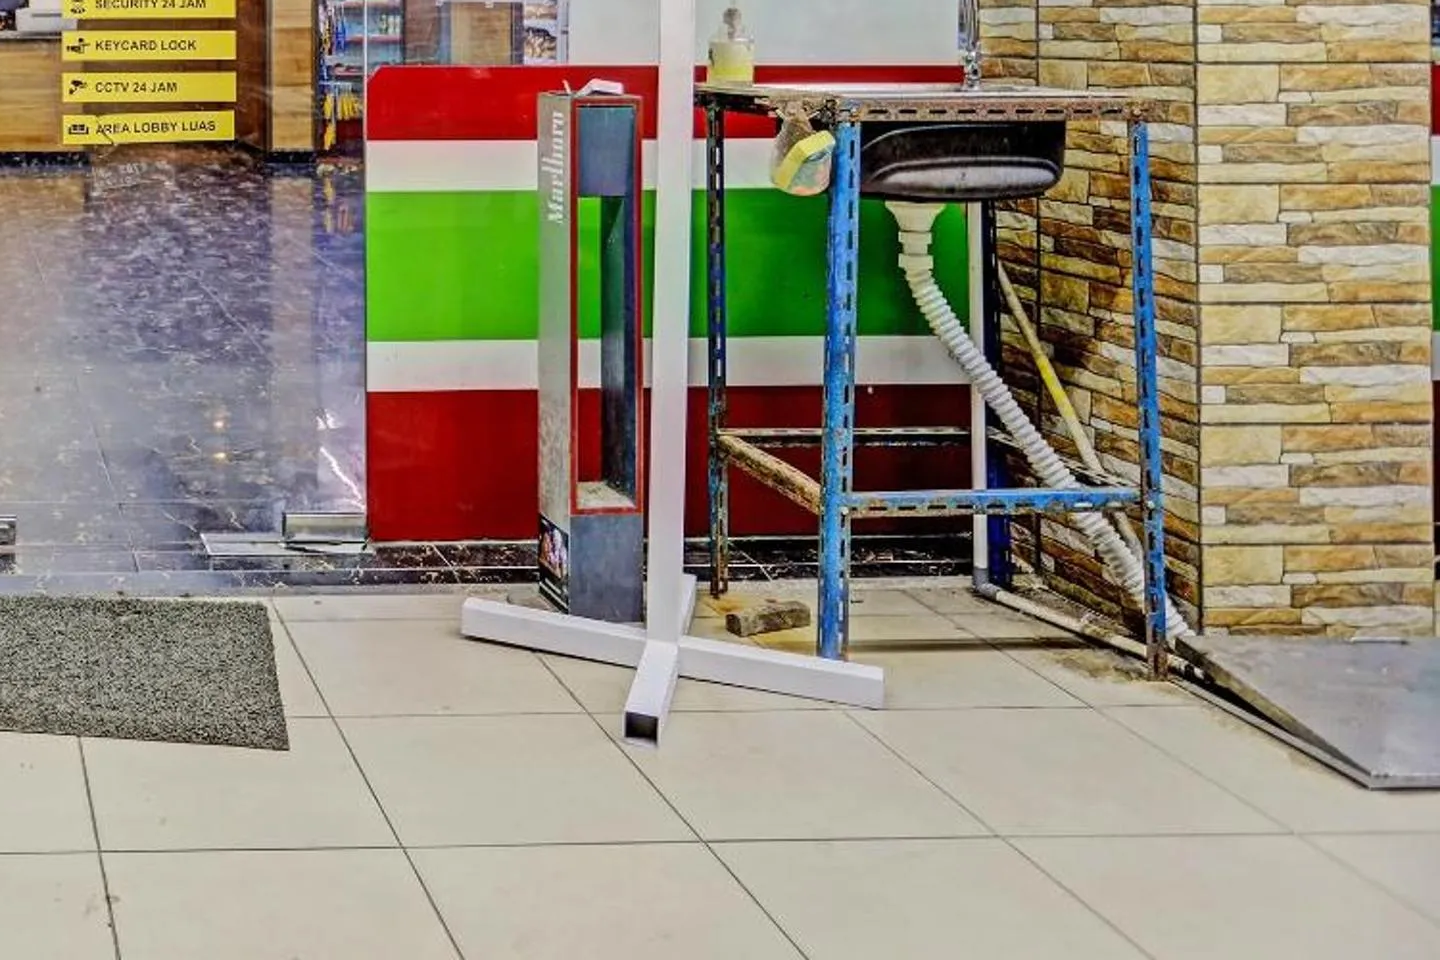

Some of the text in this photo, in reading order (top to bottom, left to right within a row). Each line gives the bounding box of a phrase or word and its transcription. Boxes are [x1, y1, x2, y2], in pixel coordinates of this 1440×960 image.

[95, 0, 158, 9] SECURITY
[162, 0, 177, 9] 24
[95, 40, 197, 51] KEYCARD LOCK
[95, 82, 178, 93] CCTV 24 JAM
[96, 120, 217, 135] AREA LOBBY LUAS
[540, 111, 565, 224] Marlboro
